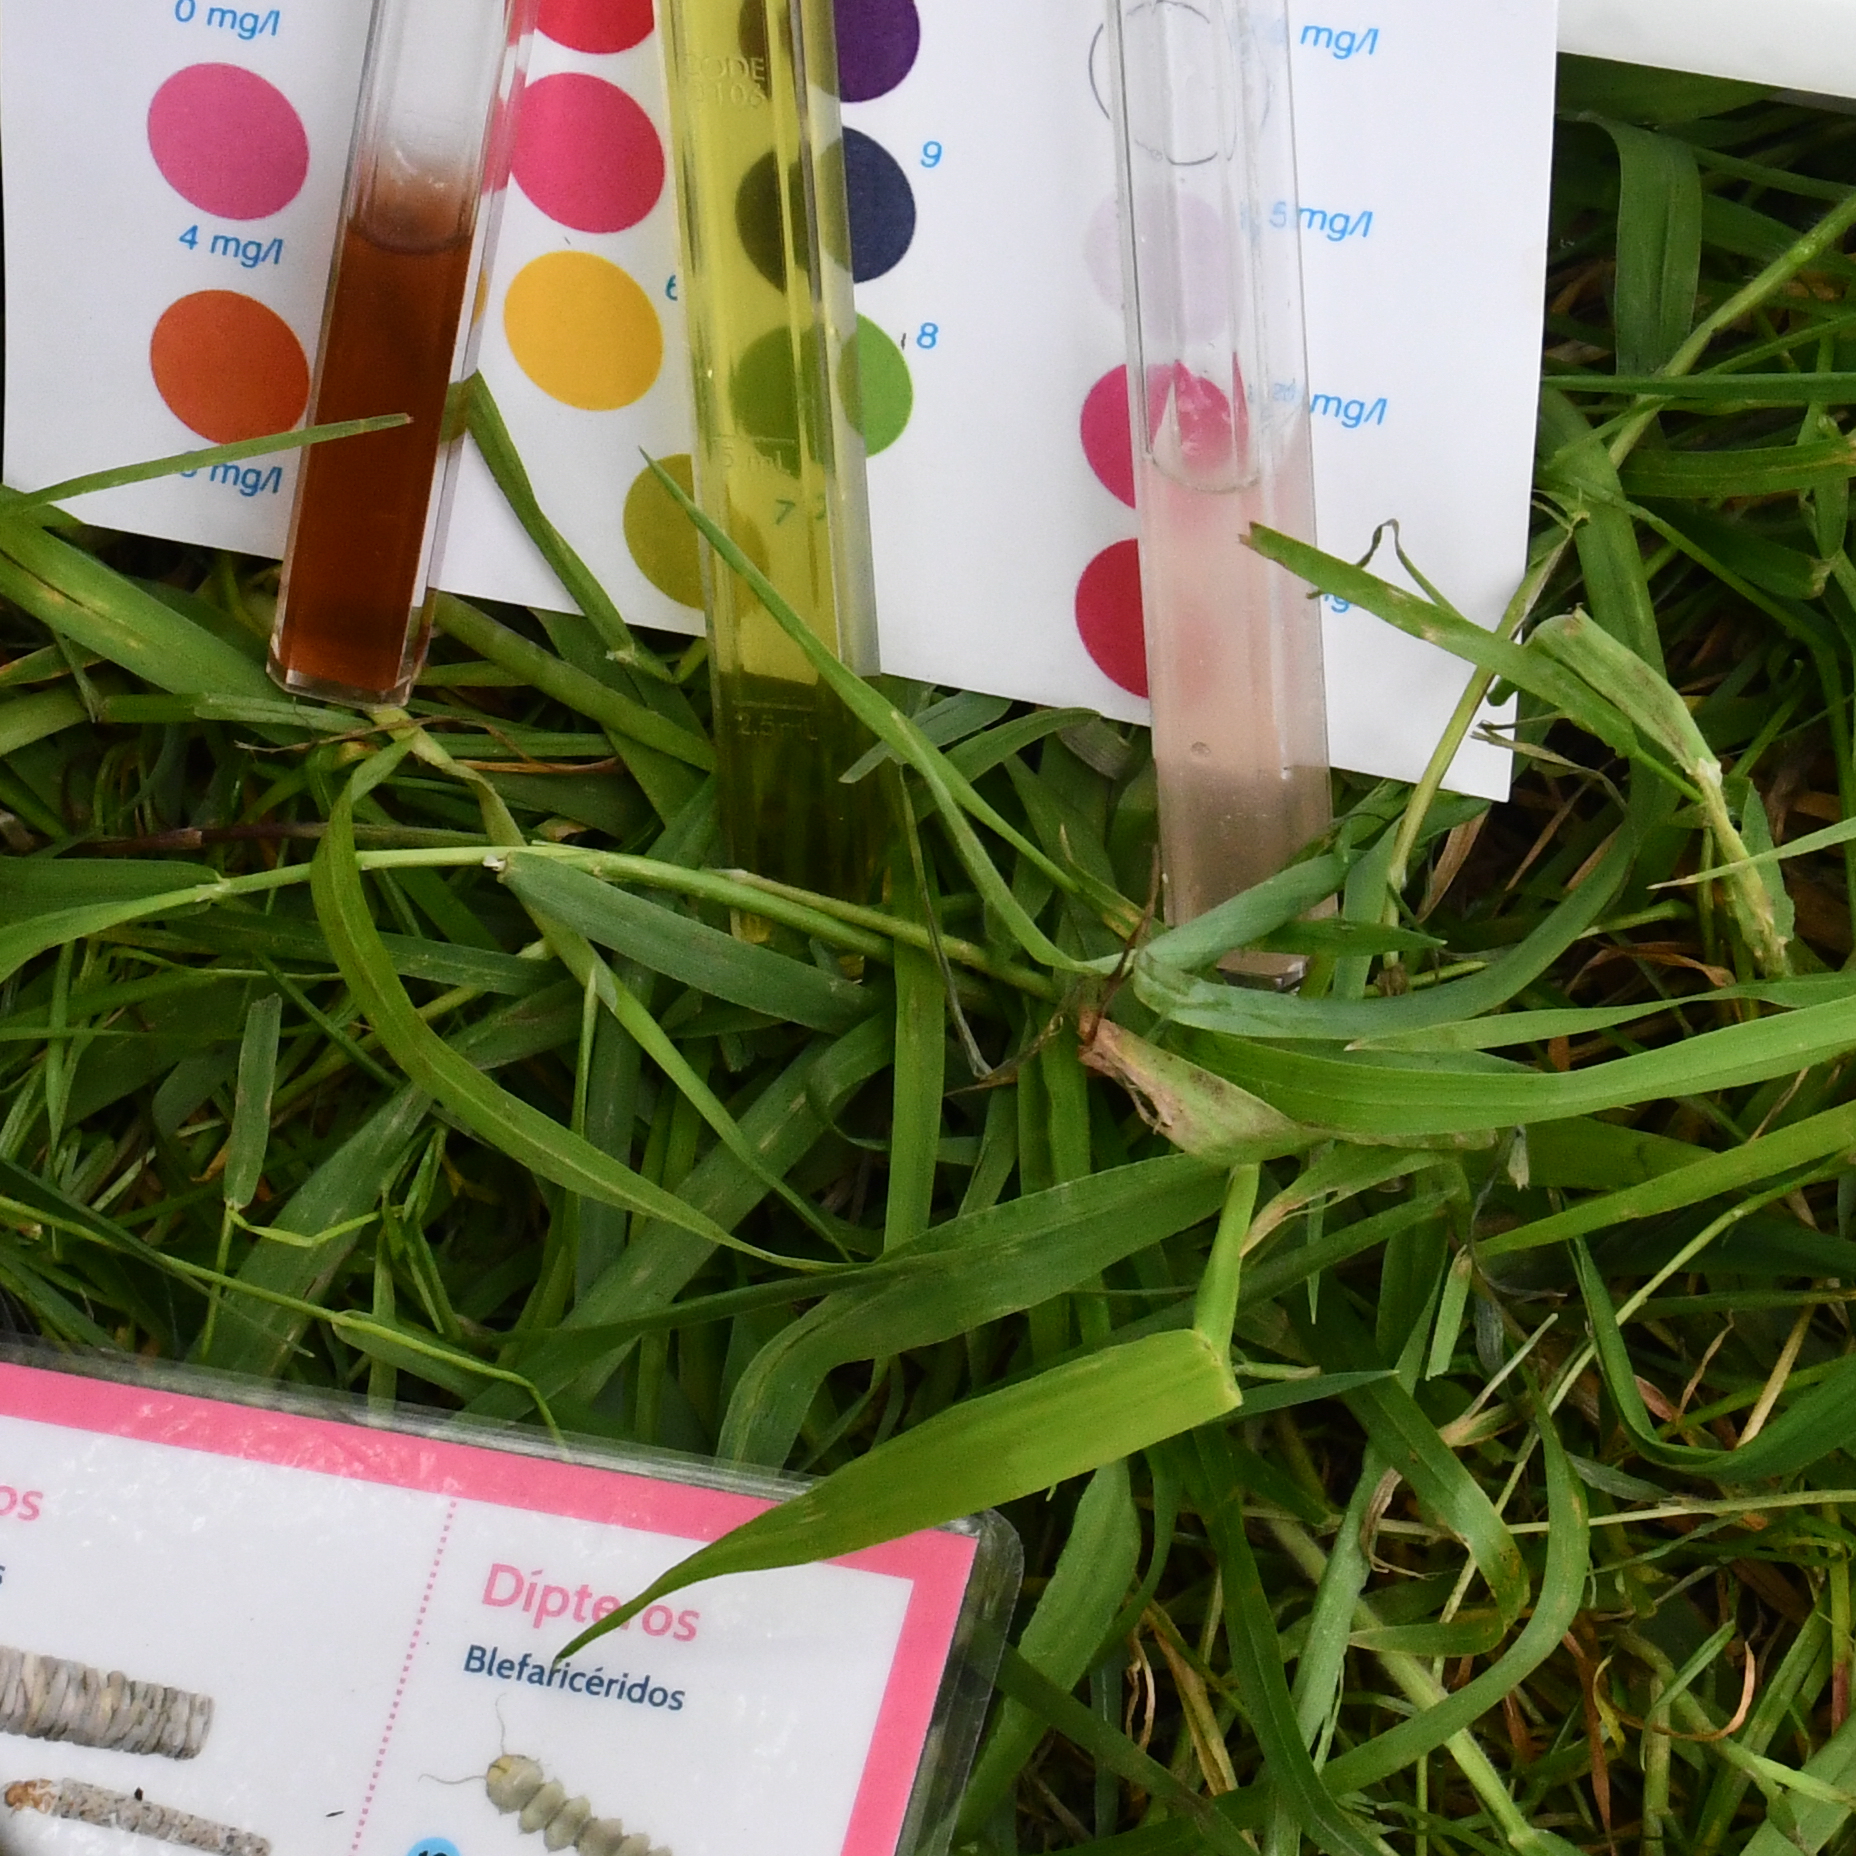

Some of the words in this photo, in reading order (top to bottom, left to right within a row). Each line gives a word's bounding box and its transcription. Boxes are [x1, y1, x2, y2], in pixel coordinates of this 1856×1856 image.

[207, 5, 280, 39] mg/l
[1300, 24, 1380, 60] mg/l
[919, 141, 943, 168] 9
[1298, 206, 1373, 242] mg/l
[179, 224, 198, 249] 4
[209, 234, 284, 268] mg/l
[916, 322, 939, 350] 8
[1310, 393, 1388, 429] mg/l
[482, 1562, 700, 1642] Dípteos
[463, 1644, 686, 1711] Blefaricéridos
